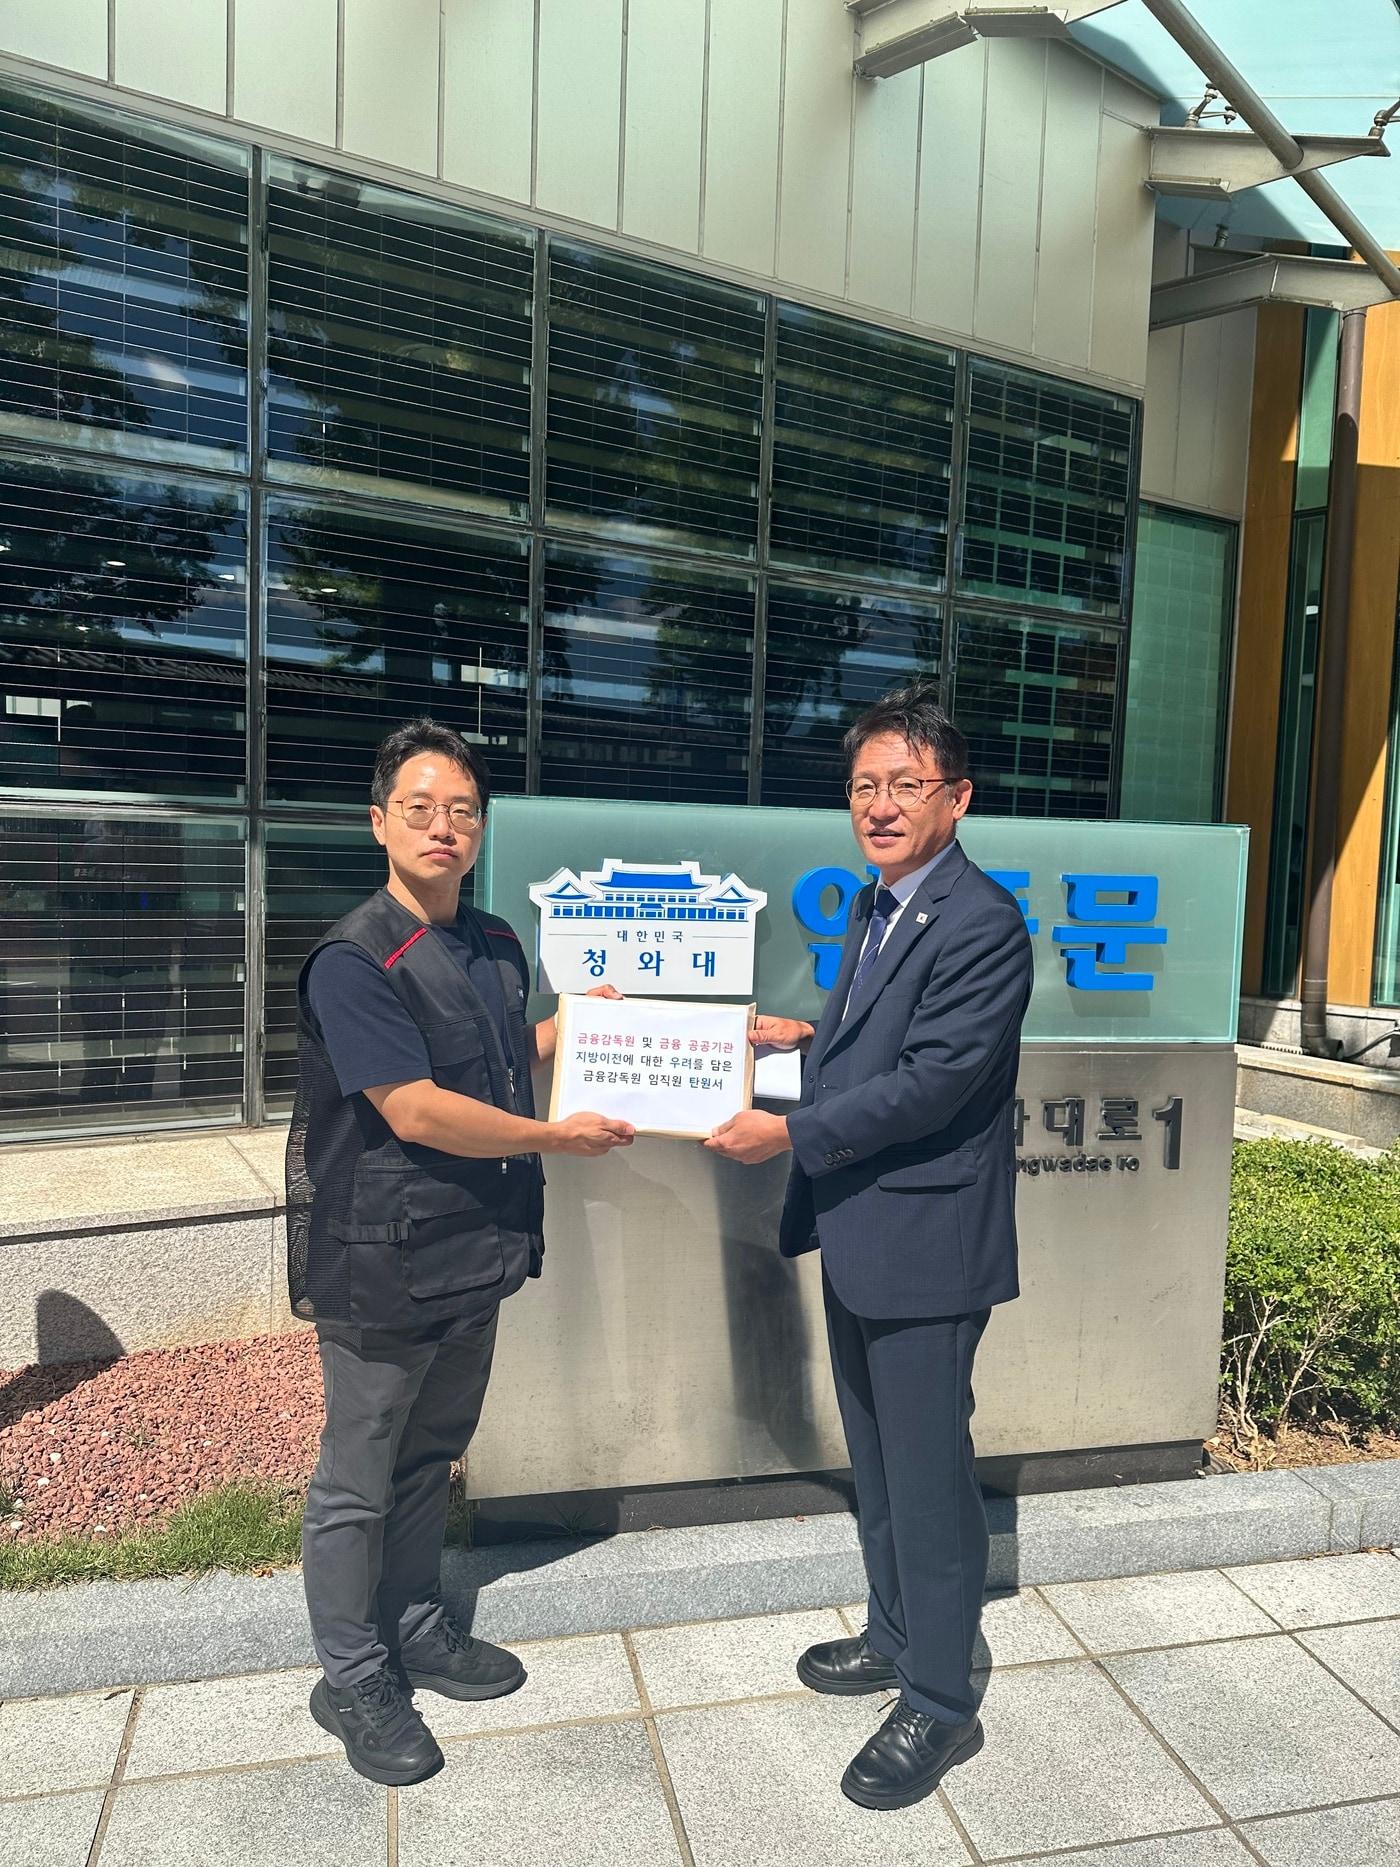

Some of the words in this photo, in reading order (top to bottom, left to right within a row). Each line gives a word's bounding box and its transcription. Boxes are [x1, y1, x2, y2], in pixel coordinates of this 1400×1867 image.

[616, 930, 683, 943] 대한민국
[582, 949, 716, 977] 청와대
[577, 1032, 635, 1048] 금융감독원
[642, 1036, 653, 1049] 및
[659, 1037, 682, 1051] 금융
[688, 1039, 734, 1054] 공공기관
[575, 1051, 634, 1066] 지방이전에
[640, 1055, 663, 1068] 대한
[669, 1056, 704, 1071] 우려를
[710, 1059, 733, 1072] 담은
[583, 1069, 641, 1085] 금융감독원
[648, 1073, 682, 1088] 임직원
[689, 1076, 724, 1091] 탄원서
[1116, 1155, 1140, 1172] ro
